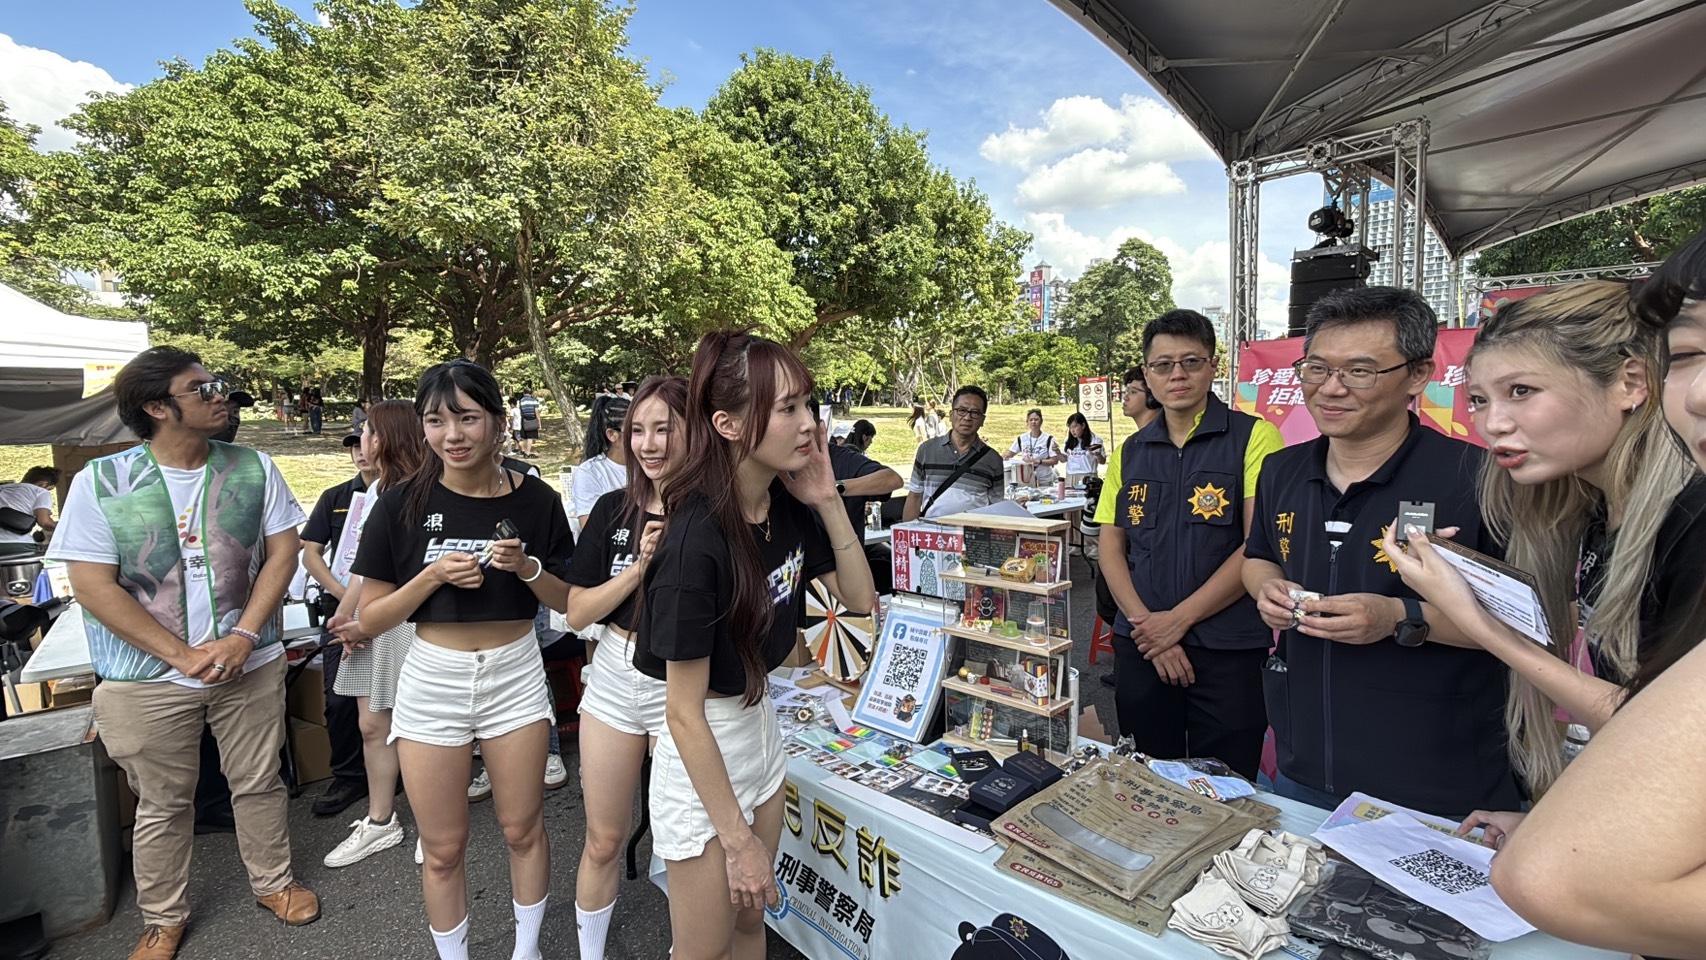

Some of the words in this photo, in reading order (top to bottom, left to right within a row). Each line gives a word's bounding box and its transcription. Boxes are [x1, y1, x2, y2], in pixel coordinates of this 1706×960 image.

[1127, 483, 1148, 526] 刑警
[1275, 511, 1295, 562] 刑警
[776, 852, 876, 944] 刑事警察局
[789, 895, 817, 921] CRIMINAL
[818, 916, 863, 956] INVESTIGATION
